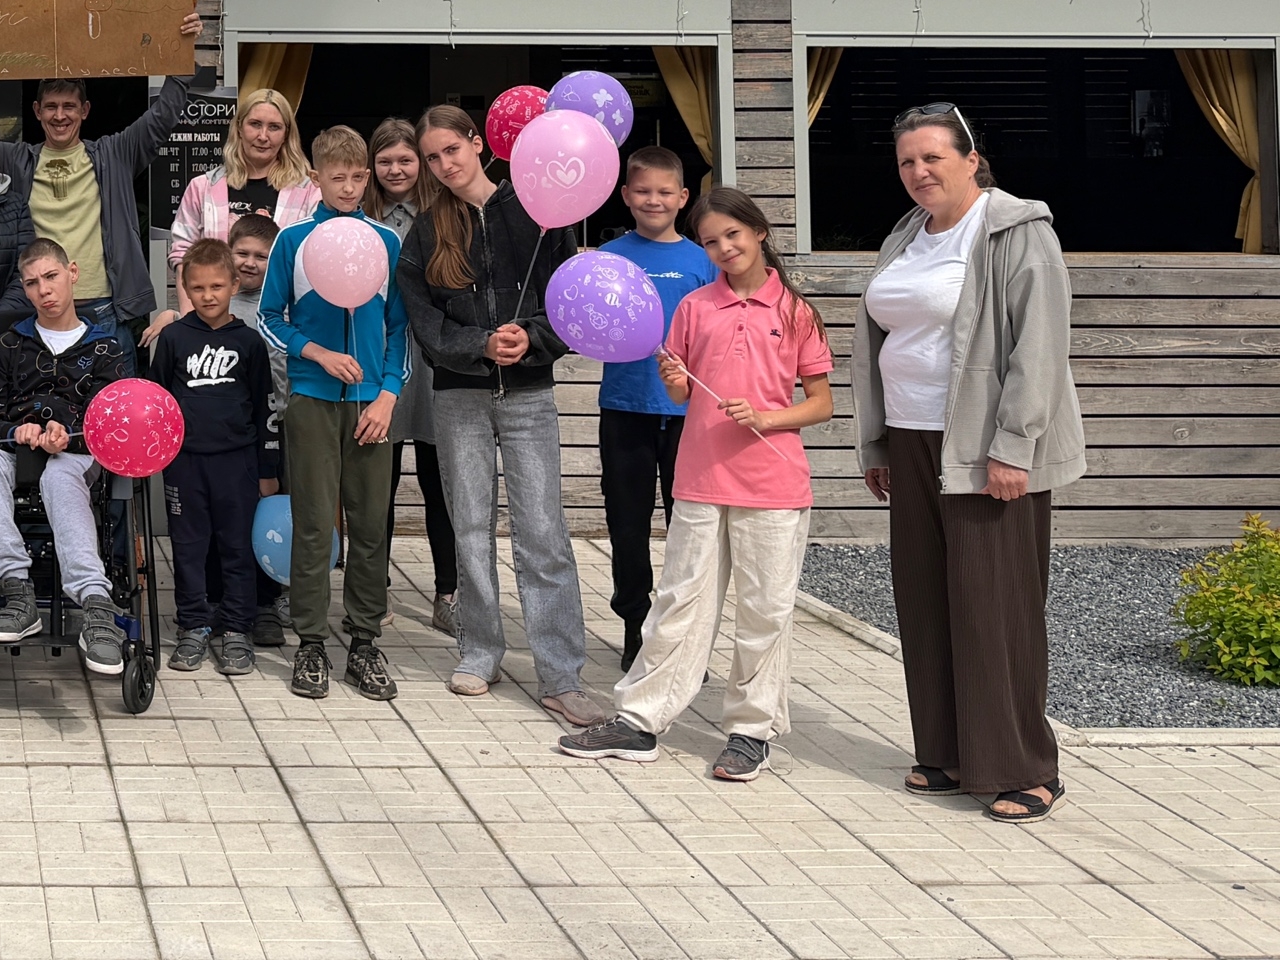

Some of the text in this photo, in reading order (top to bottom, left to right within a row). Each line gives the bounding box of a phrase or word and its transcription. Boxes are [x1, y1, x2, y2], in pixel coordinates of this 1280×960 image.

[187, 104, 236, 117] СТОРИ
[194, 133, 221, 142] РАБОТЫ
[170, 164, 180, 172] ПТ
[171, 179, 180, 188] СБ
[171, 196, 180, 204] ВС
